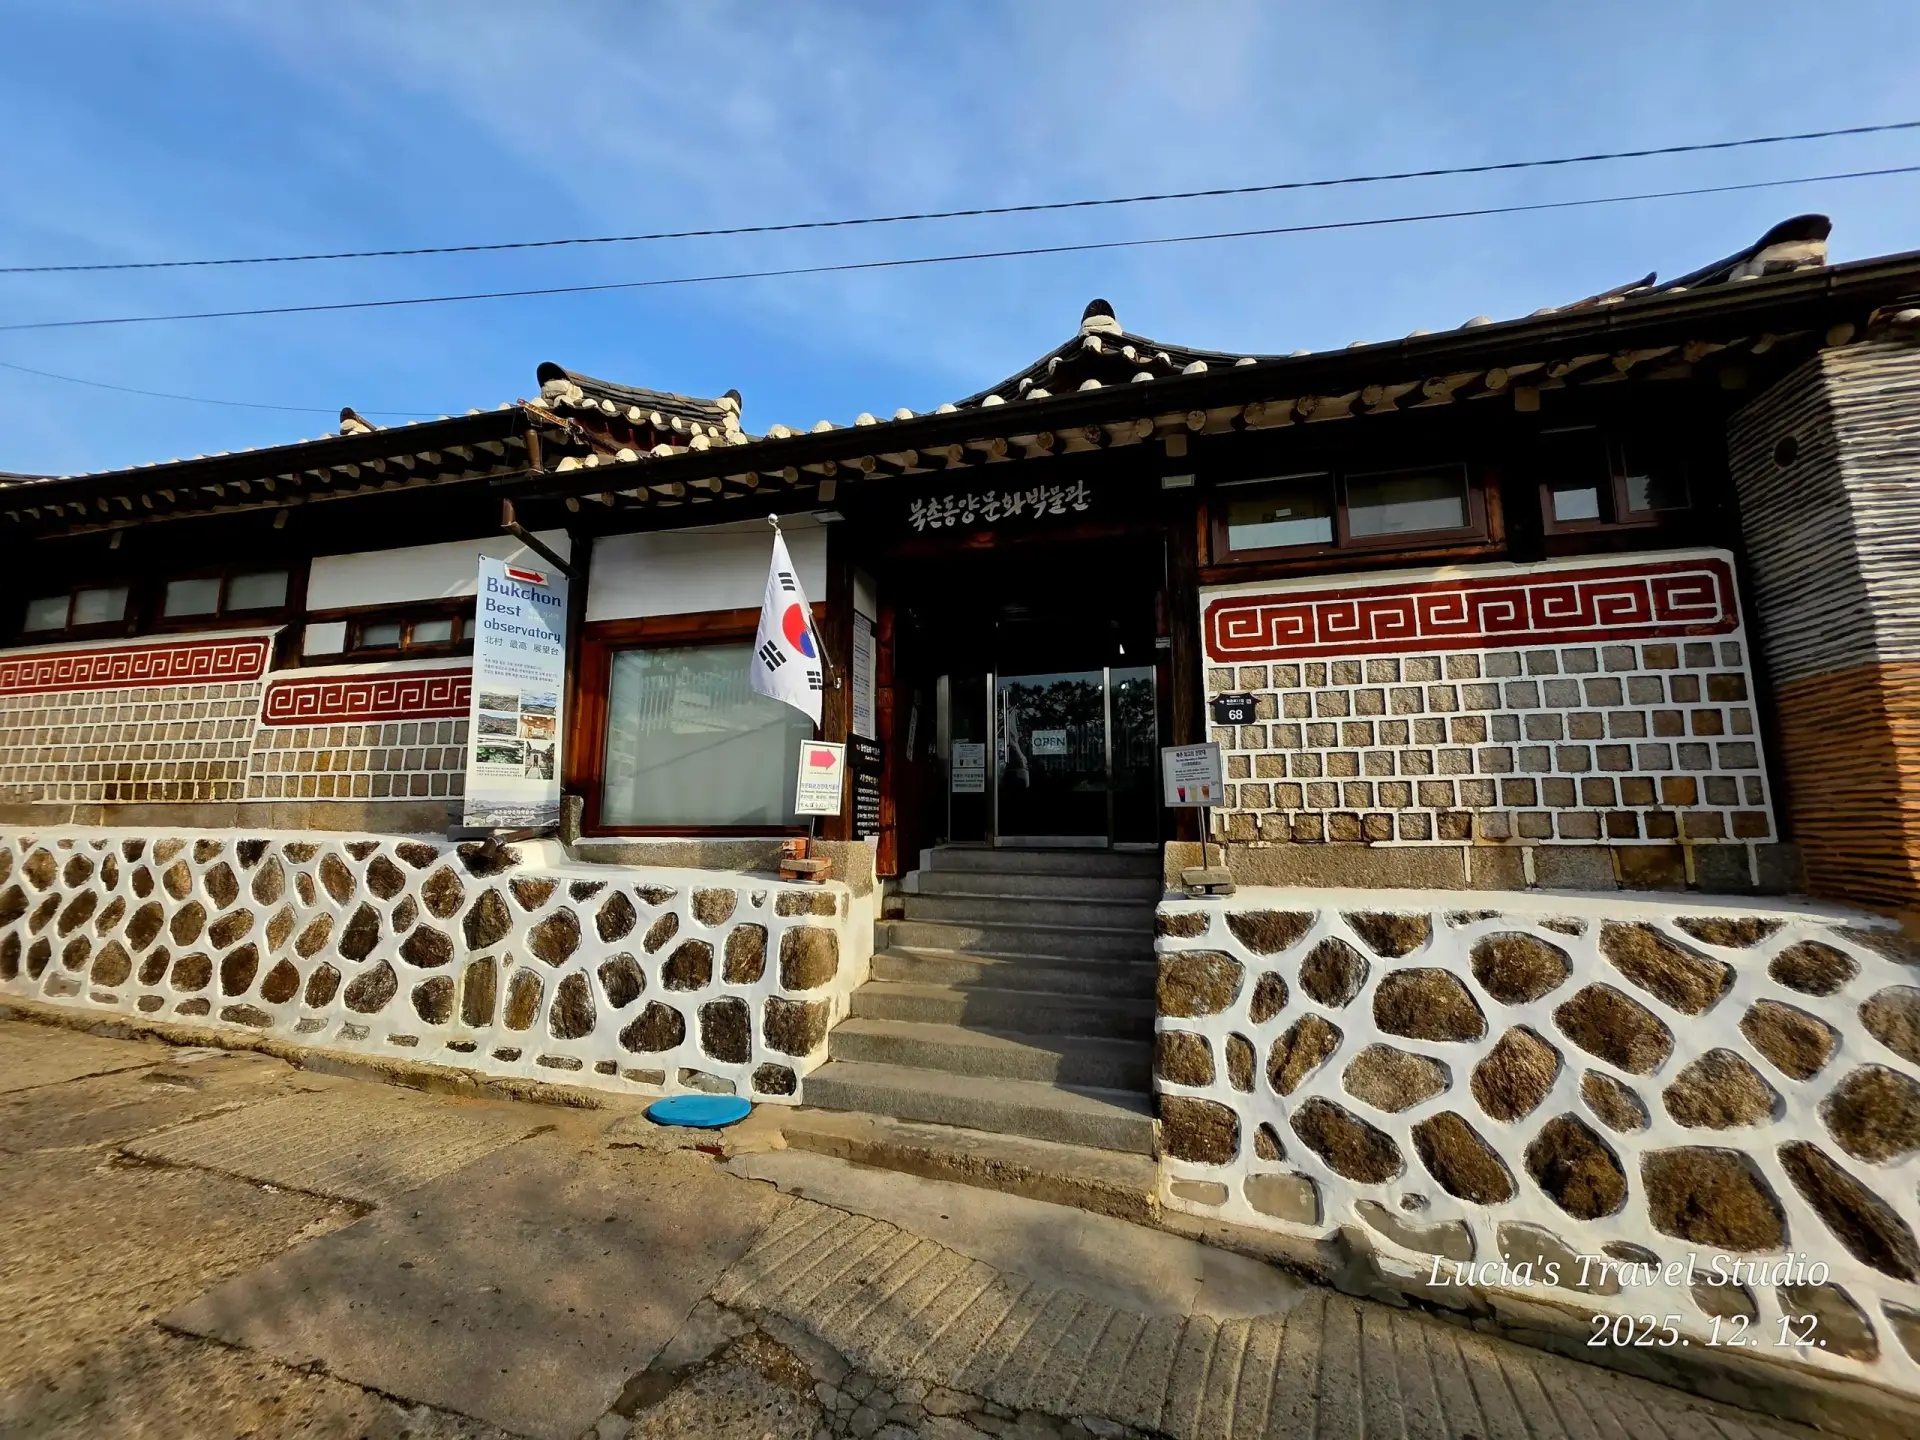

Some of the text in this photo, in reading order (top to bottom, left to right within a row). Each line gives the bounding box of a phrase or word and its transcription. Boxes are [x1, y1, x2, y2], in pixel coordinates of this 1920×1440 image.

[909, 480, 1091, 531] 북촌동양문화박물관
[487, 576, 561, 607] Bukchon
[485, 597, 522, 617] Best
[484, 618, 561, 644] observatory
[485, 636, 559, 656] 北村 最高 展望台
[1228, 709, 1243, 720] 68
[1033, 737, 1065, 747] OPEN
